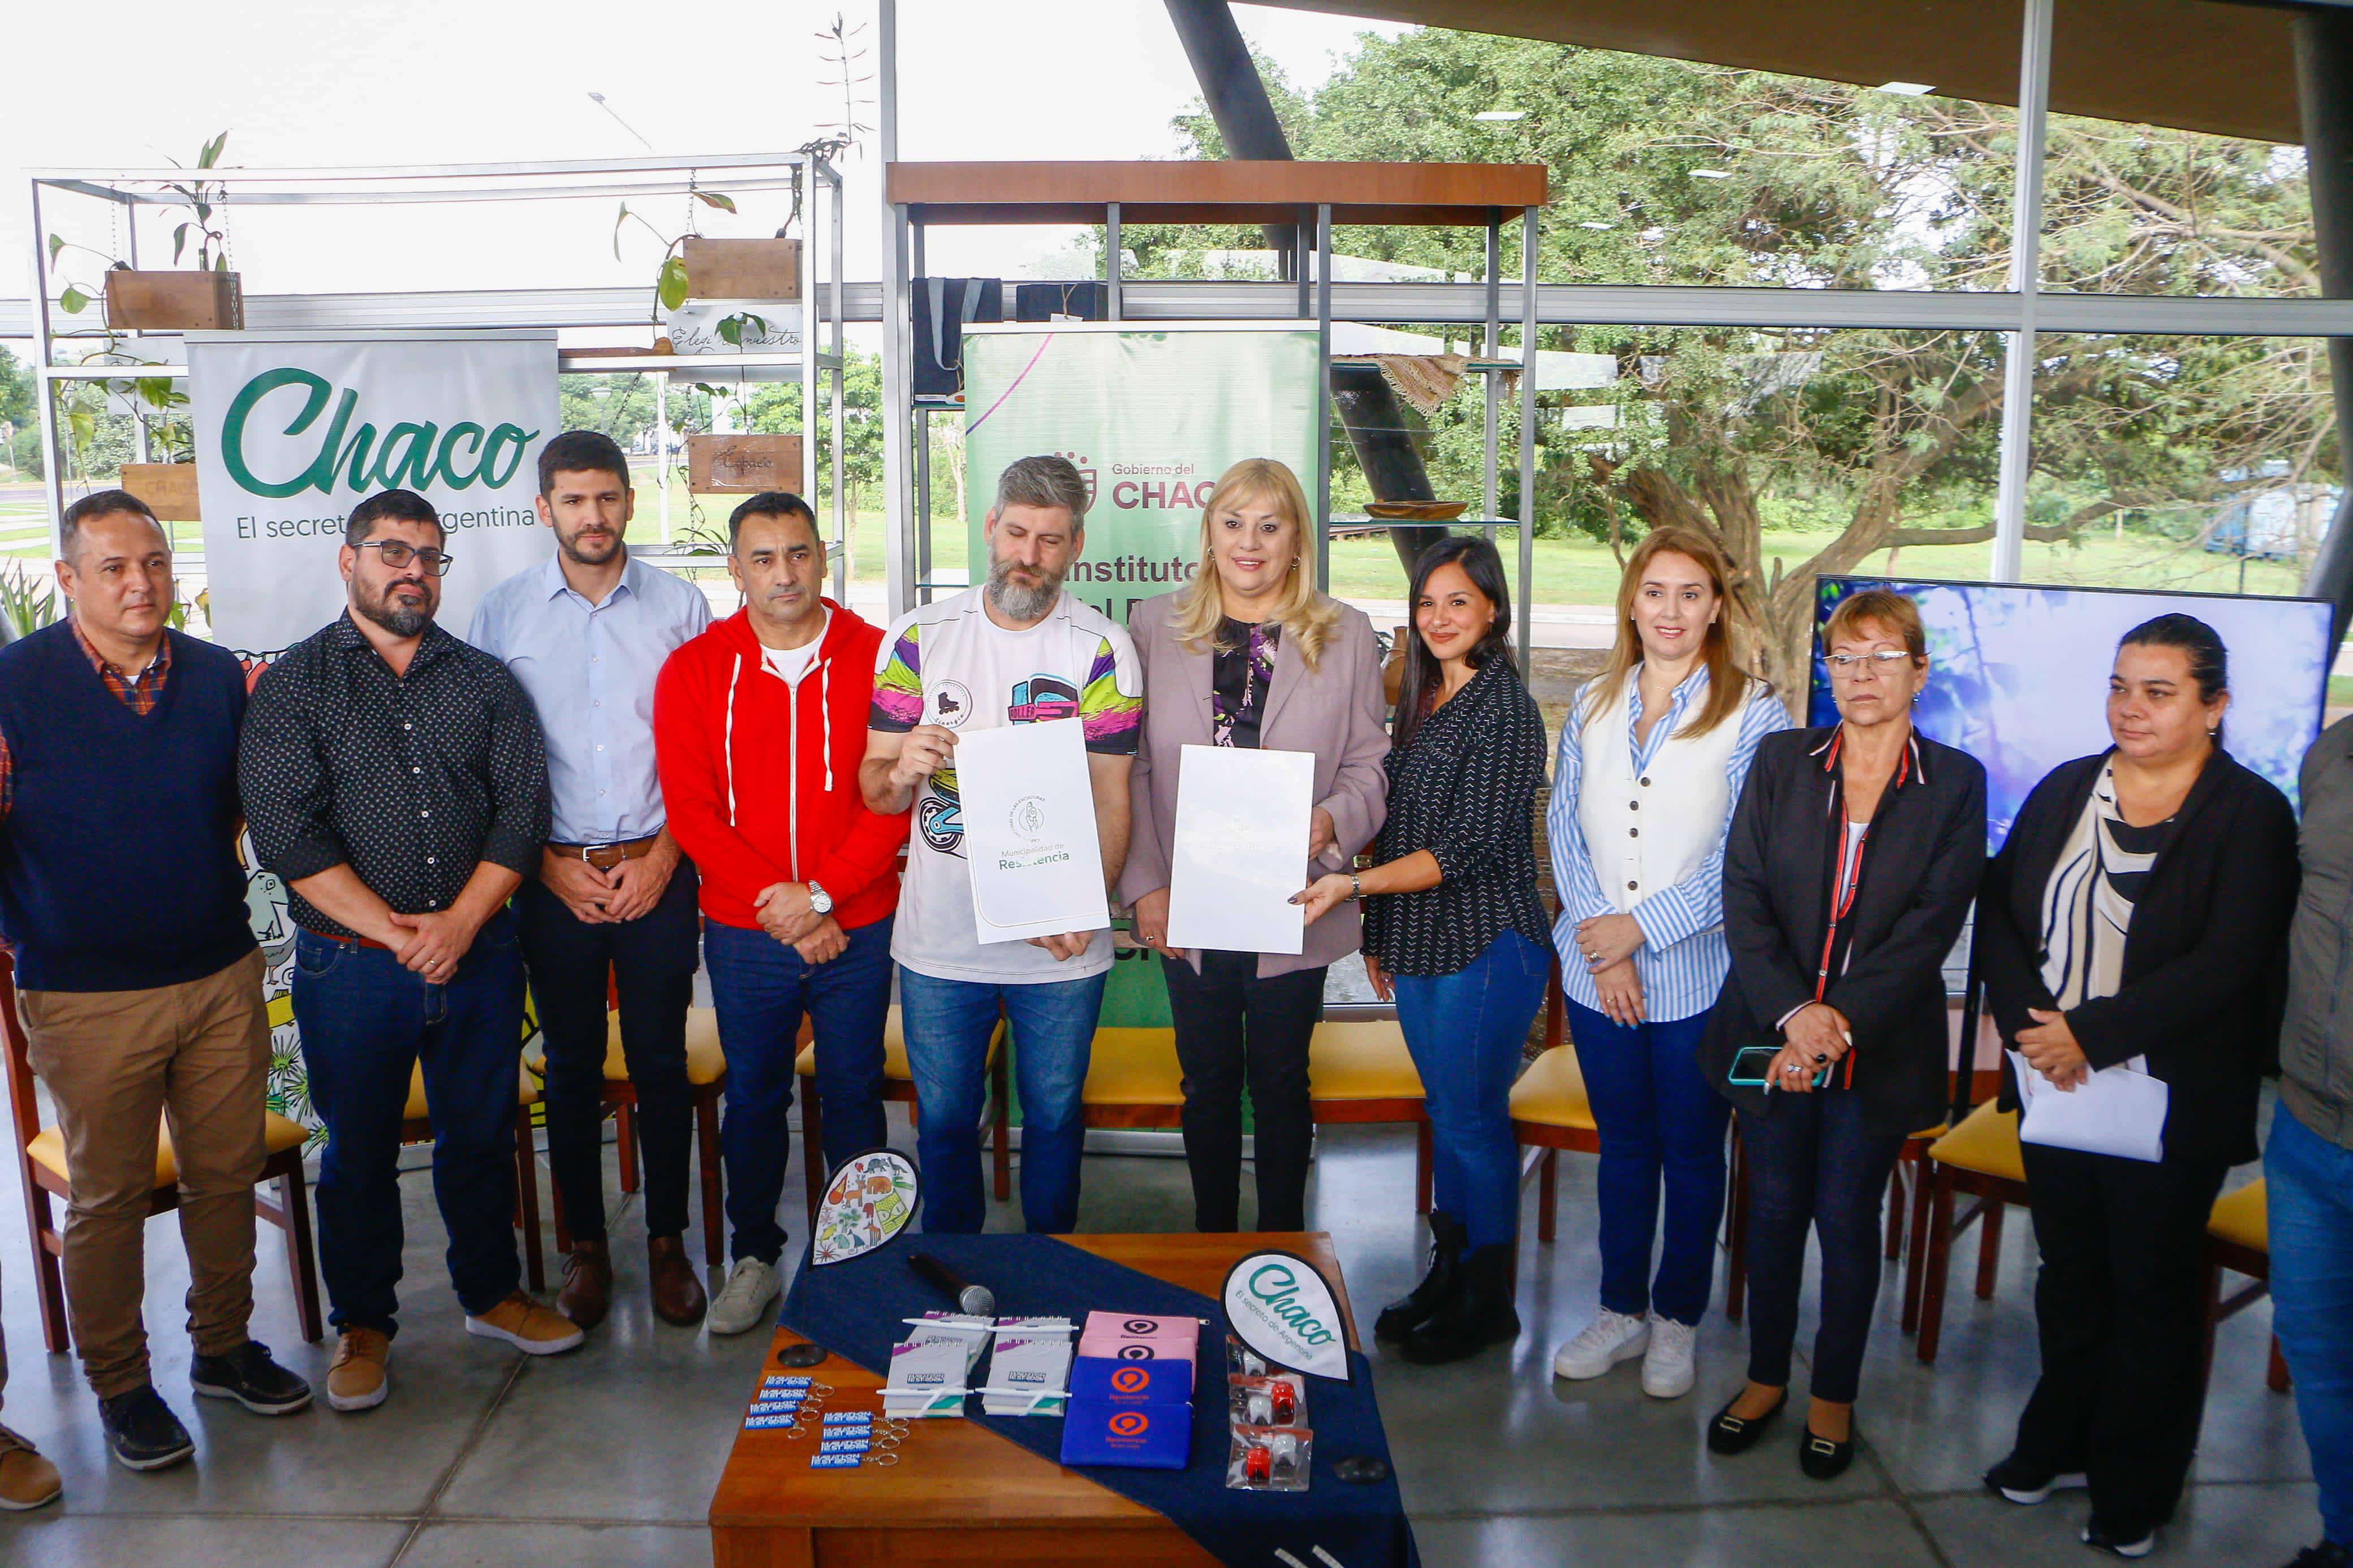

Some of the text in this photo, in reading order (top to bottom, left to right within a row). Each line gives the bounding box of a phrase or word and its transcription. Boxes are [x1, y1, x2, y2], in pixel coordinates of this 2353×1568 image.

[221, 367, 541, 499] Chaco
[1112, 463, 1194, 475] Gobierno del
[1113, 481, 1217, 509] CHAC
[236, 506, 535, 539] El secret gentina
[998, 850, 1070, 870] Resencia
[1001, 845, 1053, 858] Municipalidad
[1249, 1264, 1337, 1345] Chaco
[1235, 1290, 1313, 1361] El secreto de Argentina
